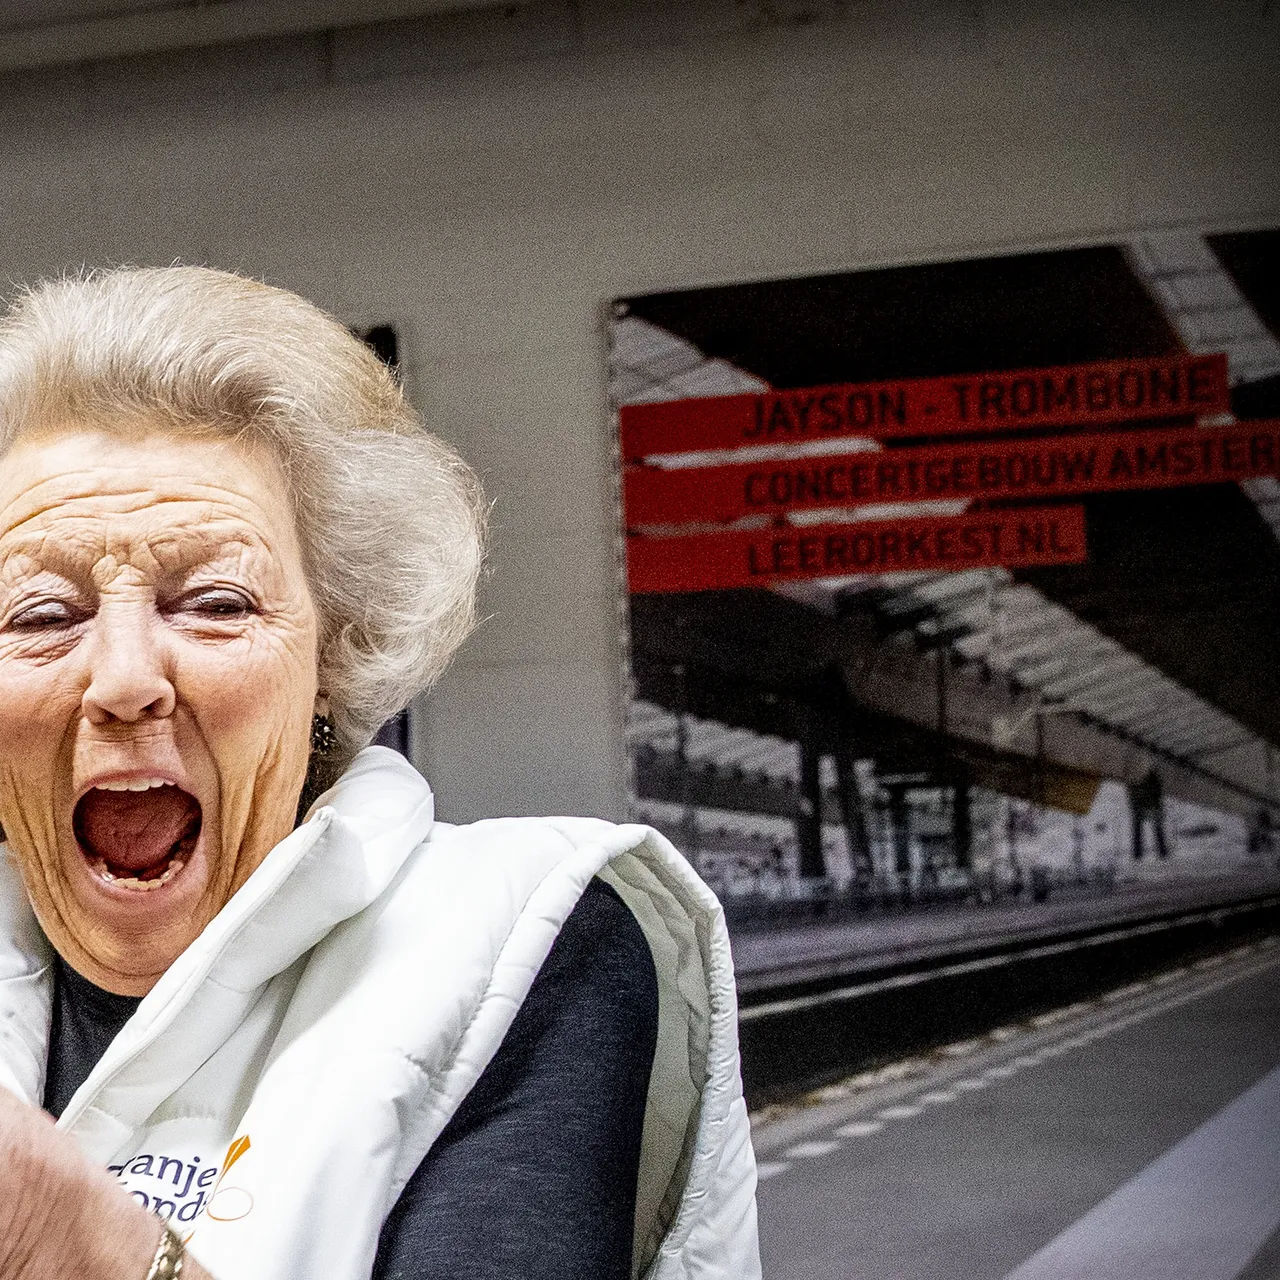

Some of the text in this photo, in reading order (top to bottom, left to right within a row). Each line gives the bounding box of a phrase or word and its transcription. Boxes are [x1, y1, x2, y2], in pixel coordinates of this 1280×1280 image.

[746, 390, 908, 437] JAYSON
[955, 367, 1219, 422] TROMBONE
[743, 431, 1280, 508] CONCERTGEBOUW AMSTER
[747, 519, 1074, 575] LEERORKEST.NL
